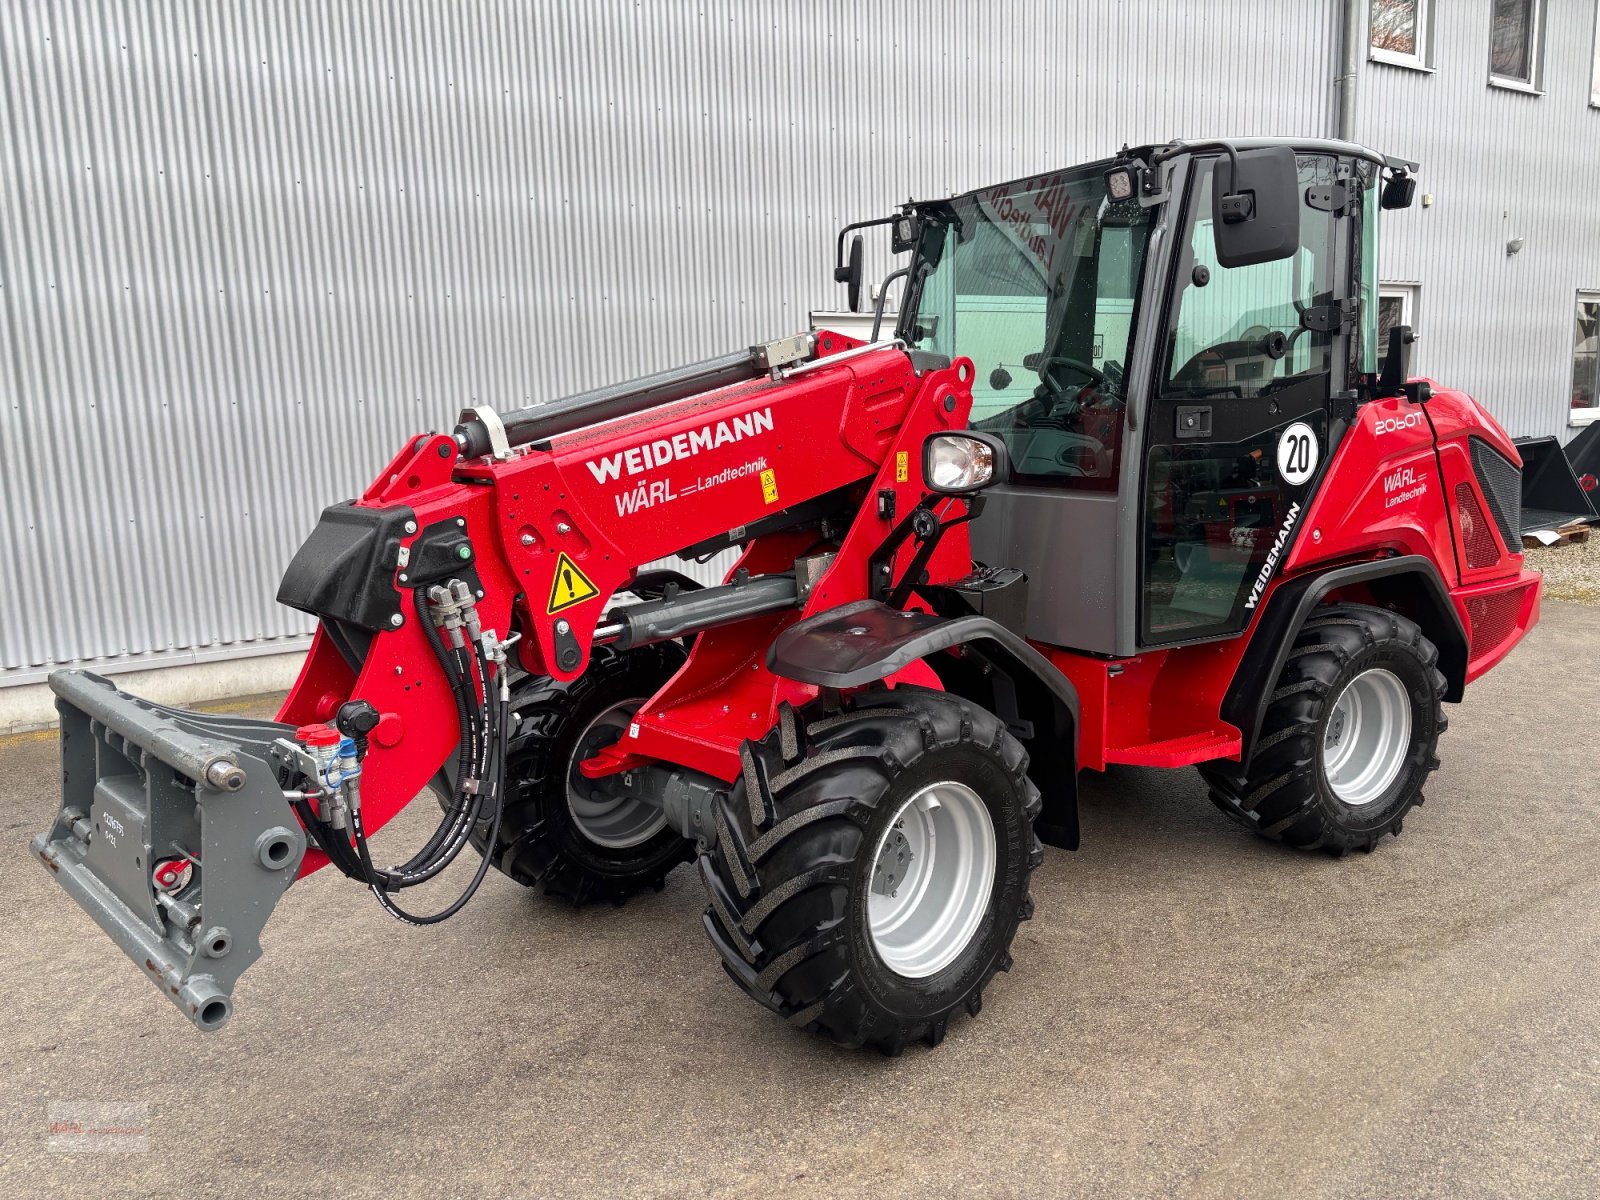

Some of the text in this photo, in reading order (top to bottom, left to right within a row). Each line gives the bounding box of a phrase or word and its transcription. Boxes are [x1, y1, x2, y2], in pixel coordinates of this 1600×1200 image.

[1375, 411, 1422, 436] 2060T
[585, 407, 775, 485] WEIDEMANN
[1286, 434, 1310, 474] 20
[614, 456, 768, 518] WÄRL Landtechnik
[1383, 466, 1417, 494] WÄRL
[1385, 483, 1427, 509] Landtechnik
[1244, 501, 1301, 609] WEIDEMANN
